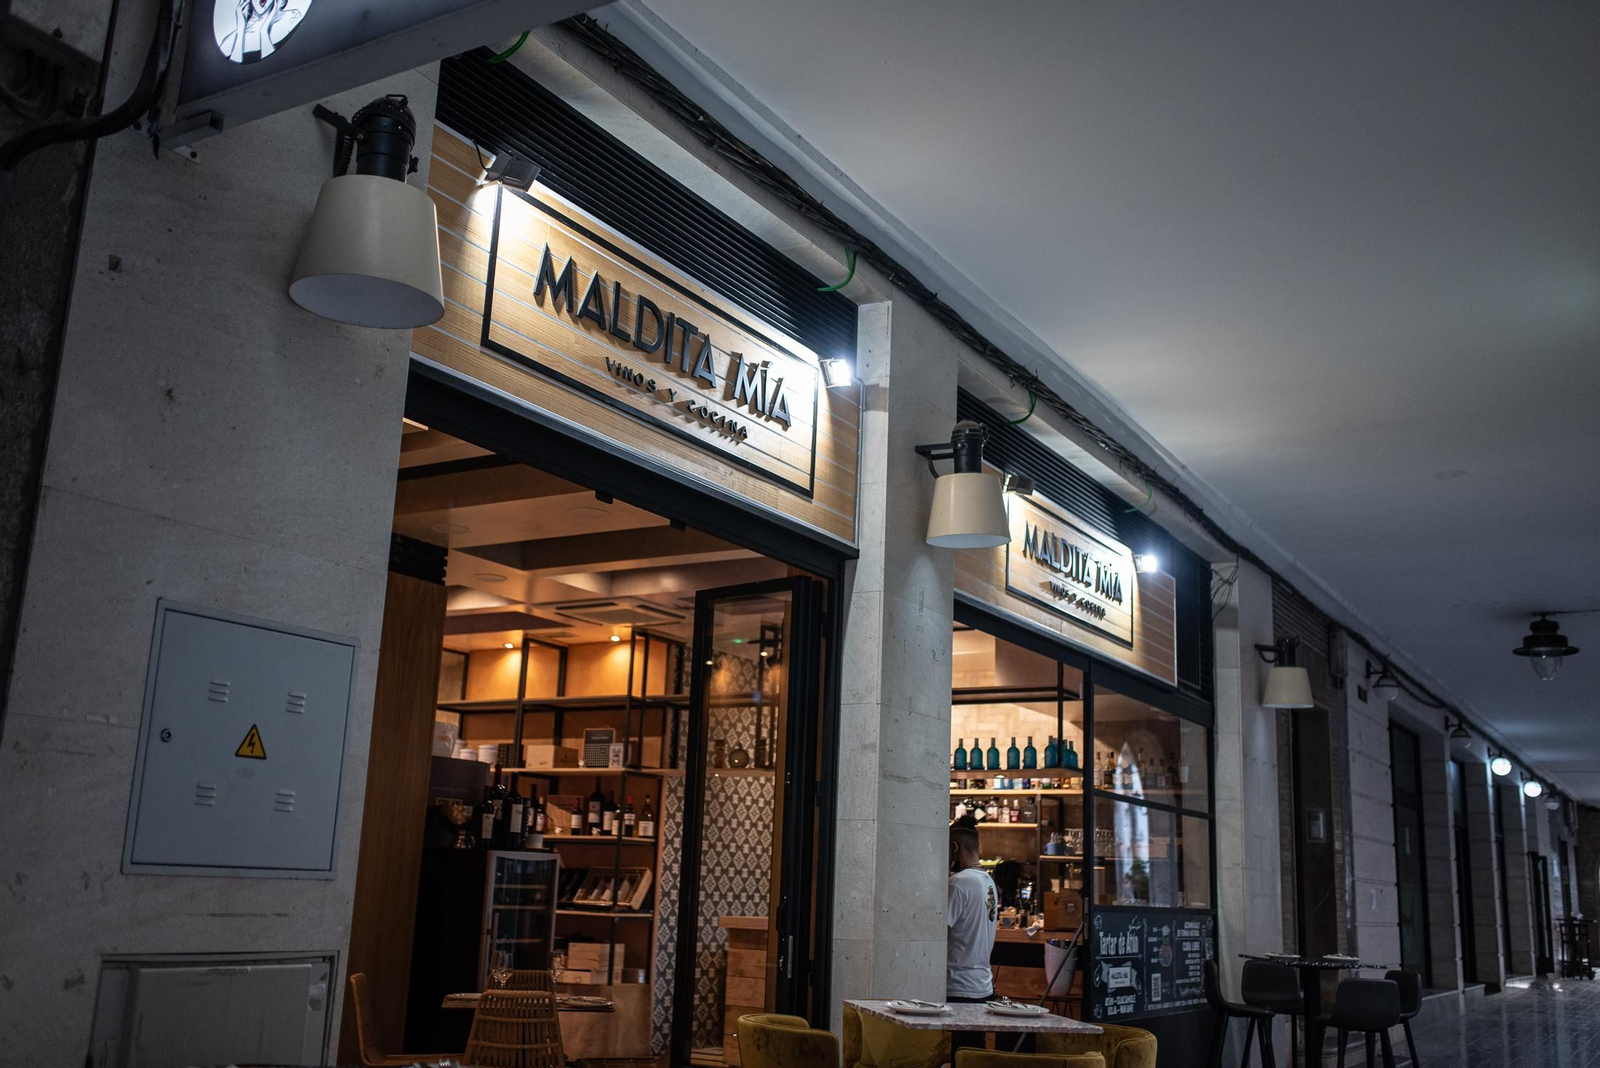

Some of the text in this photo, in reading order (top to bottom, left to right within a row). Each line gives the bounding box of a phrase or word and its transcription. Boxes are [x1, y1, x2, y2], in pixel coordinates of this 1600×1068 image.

[533, 241, 792, 428] MALDITA MÍA
[605, 356, 749, 439] VINOS Y COCINA
[1024, 520, 1092, 586] MALDITA
